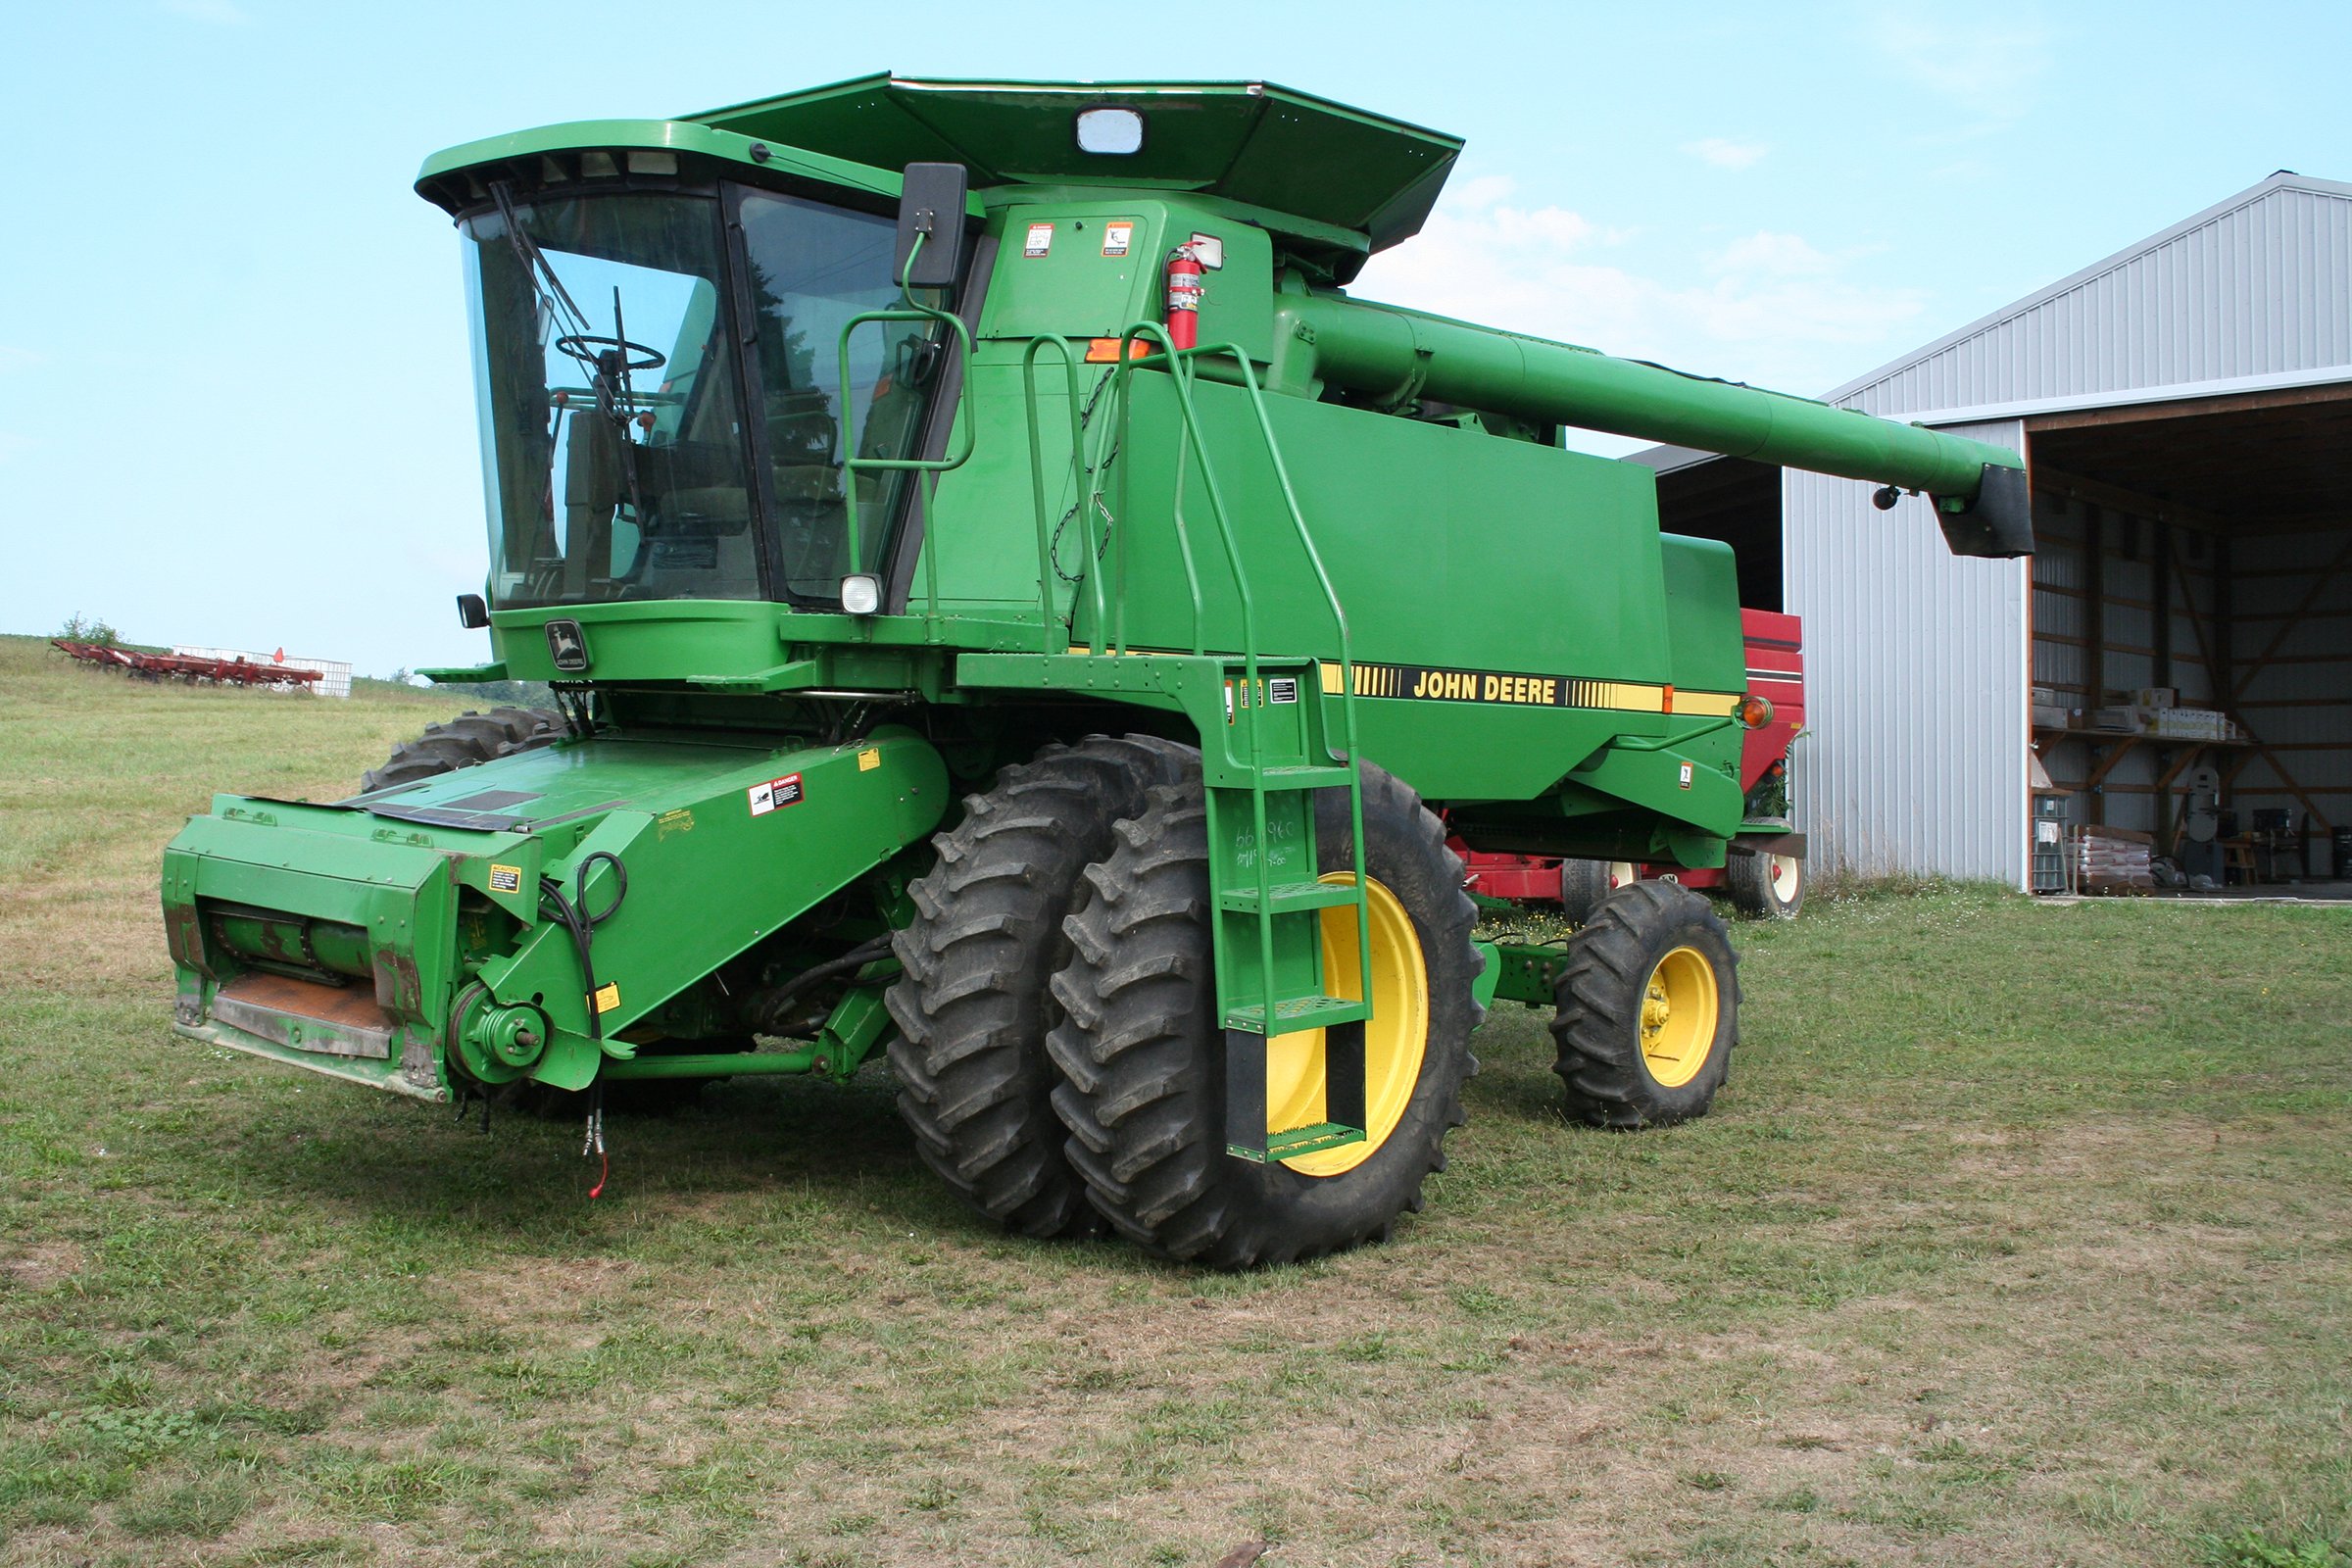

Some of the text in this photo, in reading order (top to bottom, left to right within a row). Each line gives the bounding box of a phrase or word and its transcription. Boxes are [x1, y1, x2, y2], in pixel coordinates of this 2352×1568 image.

[1413, 671, 1556, 705] JOHN DEERE
[777, 775, 798, 786] DANGER
